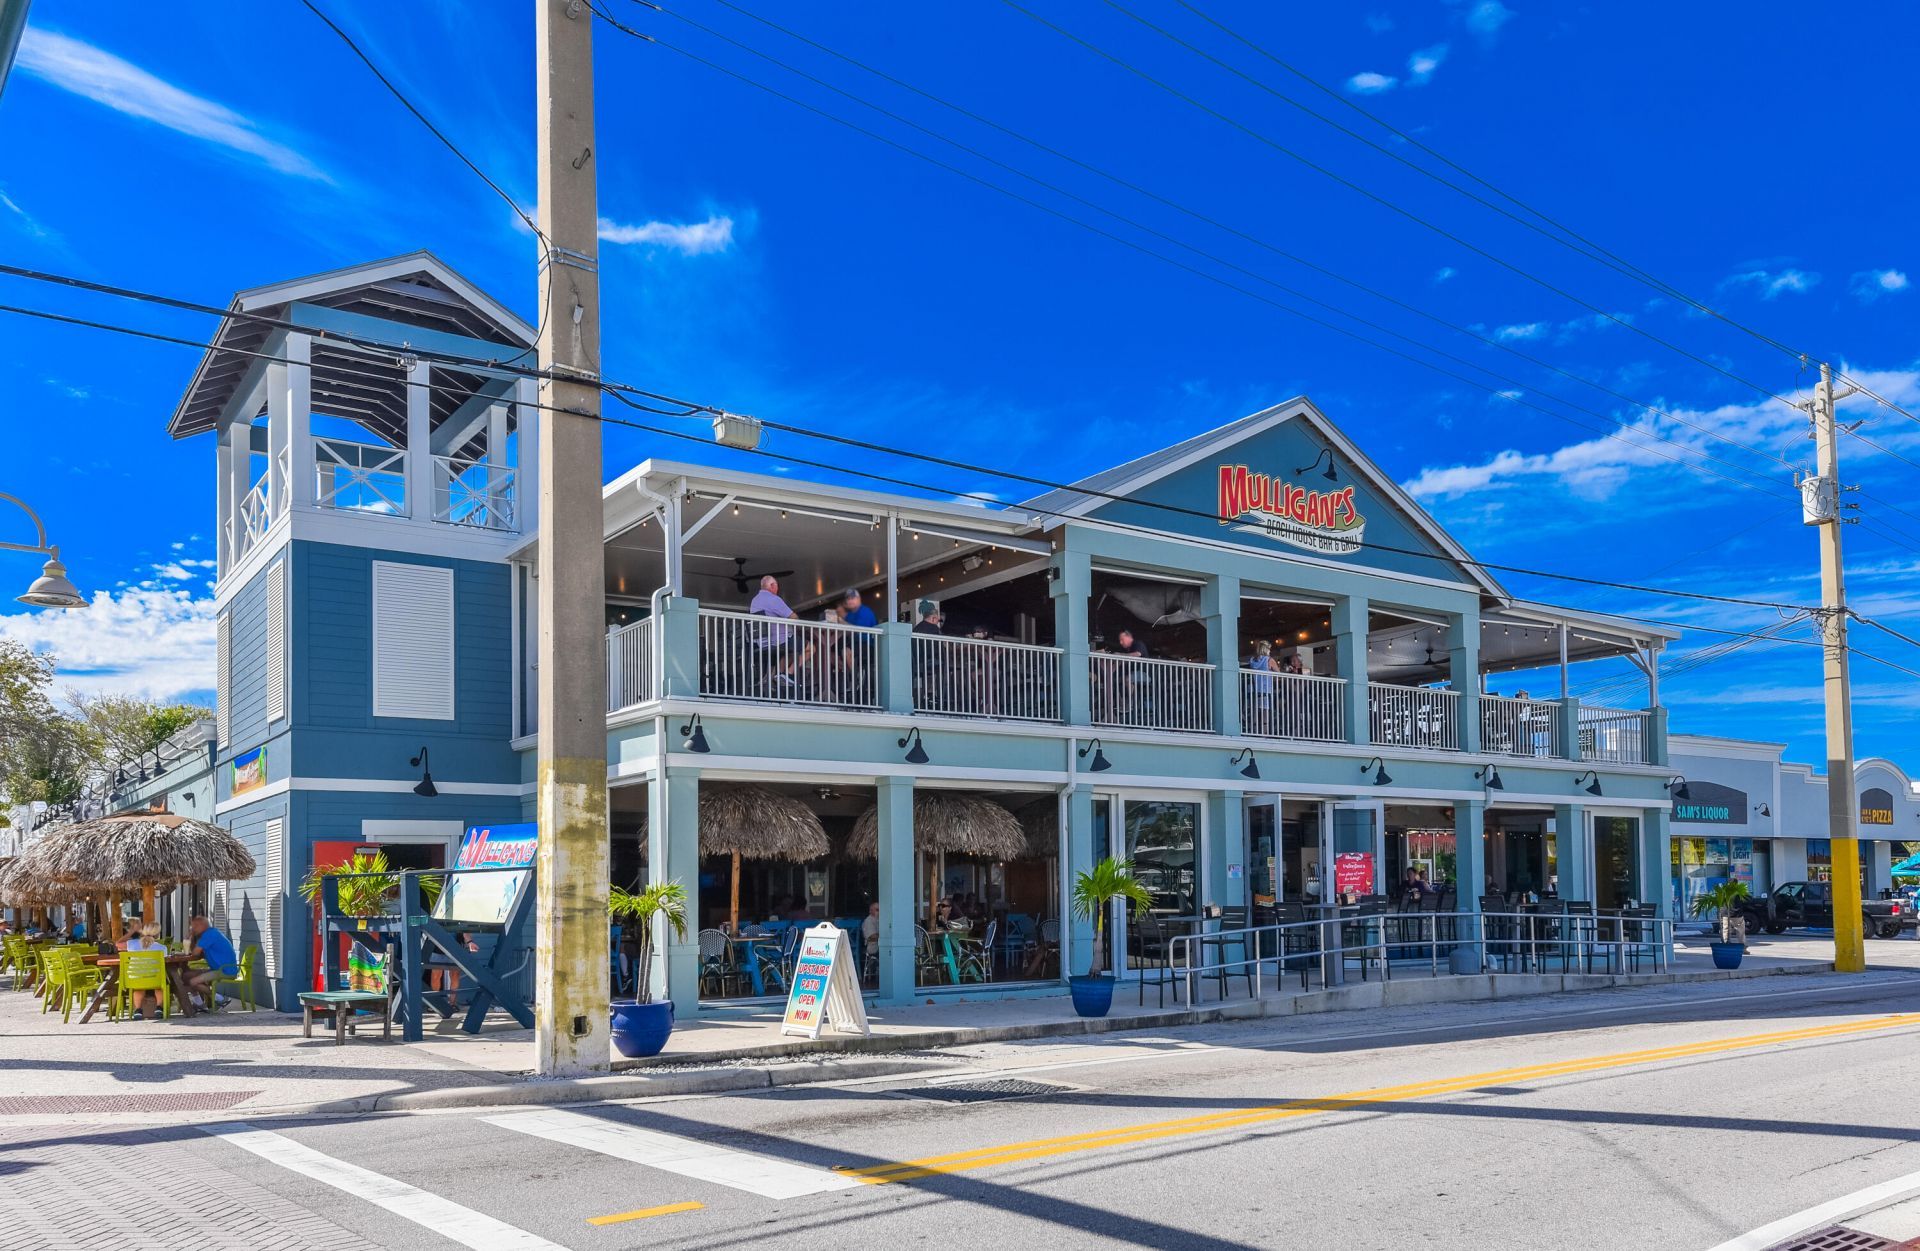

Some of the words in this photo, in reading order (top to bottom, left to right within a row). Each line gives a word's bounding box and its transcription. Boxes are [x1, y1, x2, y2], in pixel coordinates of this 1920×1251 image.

[1219, 464, 1357, 529] MULLIGAN'S
[1266, 518, 1291, 539] BEACH
[1292, 525, 1317, 548] HOUSE
[1319, 534, 1333, 551] BAR
[1341, 535, 1360, 552] GRILL
[1676, 805, 1700, 819] SAM'S
[1702, 806, 1729, 820] LIQUOR
[1872, 809, 1892, 823] PIZZA
[1732, 851, 1749, 859] LIGHT
[798, 963, 831, 976] UPSTAIRS
[801, 979, 820, 991] PATIO
[799, 994, 816, 1006] OPEN
[794, 1010, 811, 1020] NOW!
